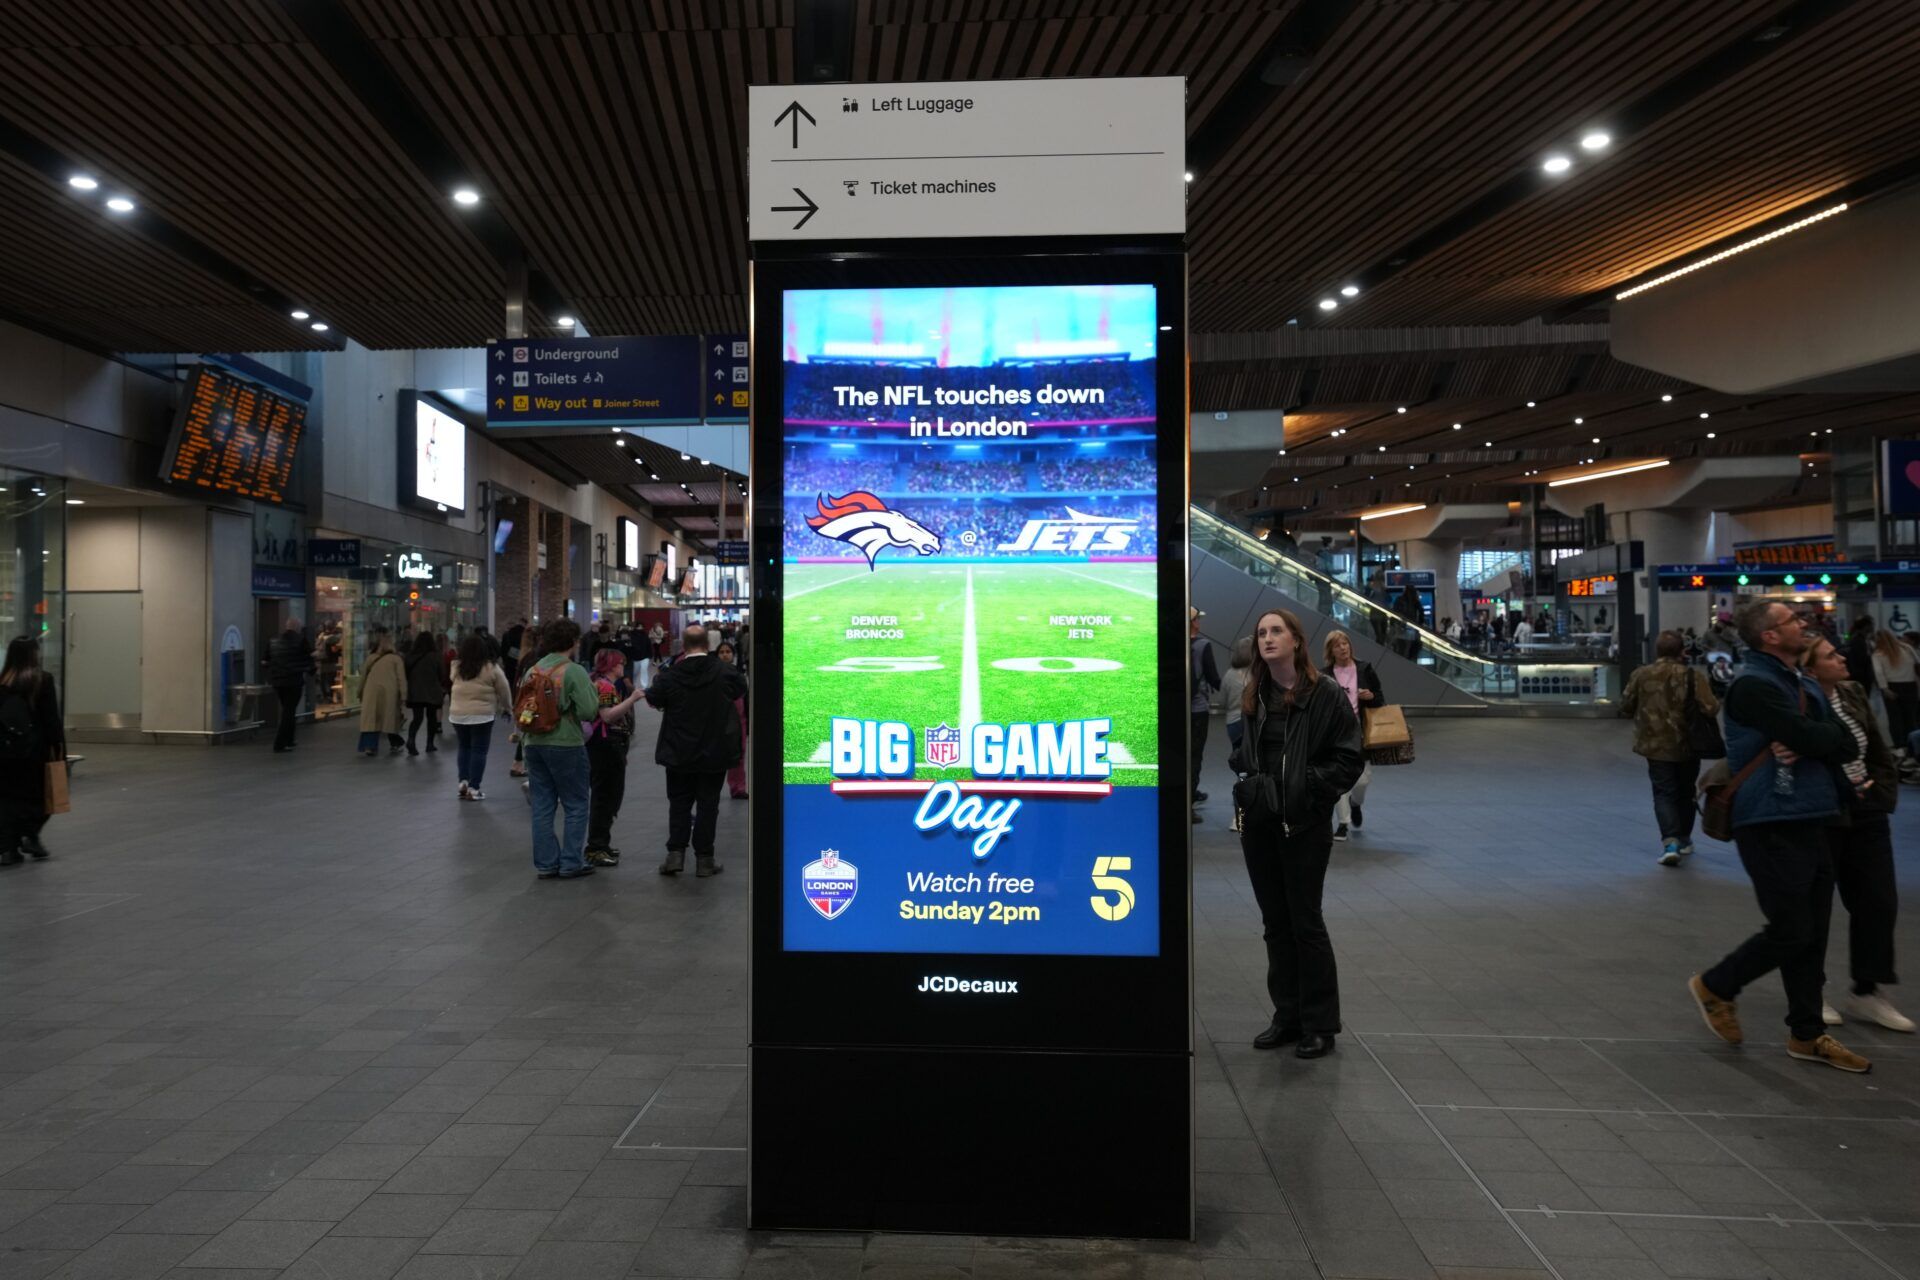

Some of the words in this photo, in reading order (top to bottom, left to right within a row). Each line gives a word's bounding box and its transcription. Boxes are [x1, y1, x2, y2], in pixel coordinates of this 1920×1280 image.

[872, 97, 902, 112] Left
[907, 96, 974, 113] Luggage
[870, 180, 917, 195] Ticket
[921, 179, 996, 194] machines
[534, 347, 620, 362] Underground
[534, 372, 577, 385] Toilets
[833, 386, 878, 406] The
[883, 385, 931, 405] NFL
[935, 385, 1031, 405] touches
[1036, 384, 1105, 404] down
[534, 398, 561, 411] Way
[565, 398, 587, 409] out
[604, 399, 630, 408] Joiner
[632, 398, 660, 408] Street
[910, 416, 931, 437] in
[937, 416, 1027, 436] London
[960, 530, 977, 546] @
[997, 518, 1140, 551] JETS
[851, 616, 898, 626] DENVER
[1049, 616, 1078, 626] NEW
[1079, 615, 1112, 626] YORK
[845, 629, 904, 640] BRONCOS
[1067, 628, 1094, 639] JETS
[831, 716, 914, 780] BIG
[929, 742, 958, 761] NFL
[972, 717, 1112, 780] GAME
[914, 780, 1022, 860] Day
[807, 882, 853, 890] LONDON
[906, 872, 981, 893] Watch
[987, 872, 1035, 893] free
[1090, 856, 1136, 921] 5
[899, 900, 985, 925] Sunday
[988, 901, 1040, 924] 2pm
[918, 976, 1018, 993] JCDecaux
